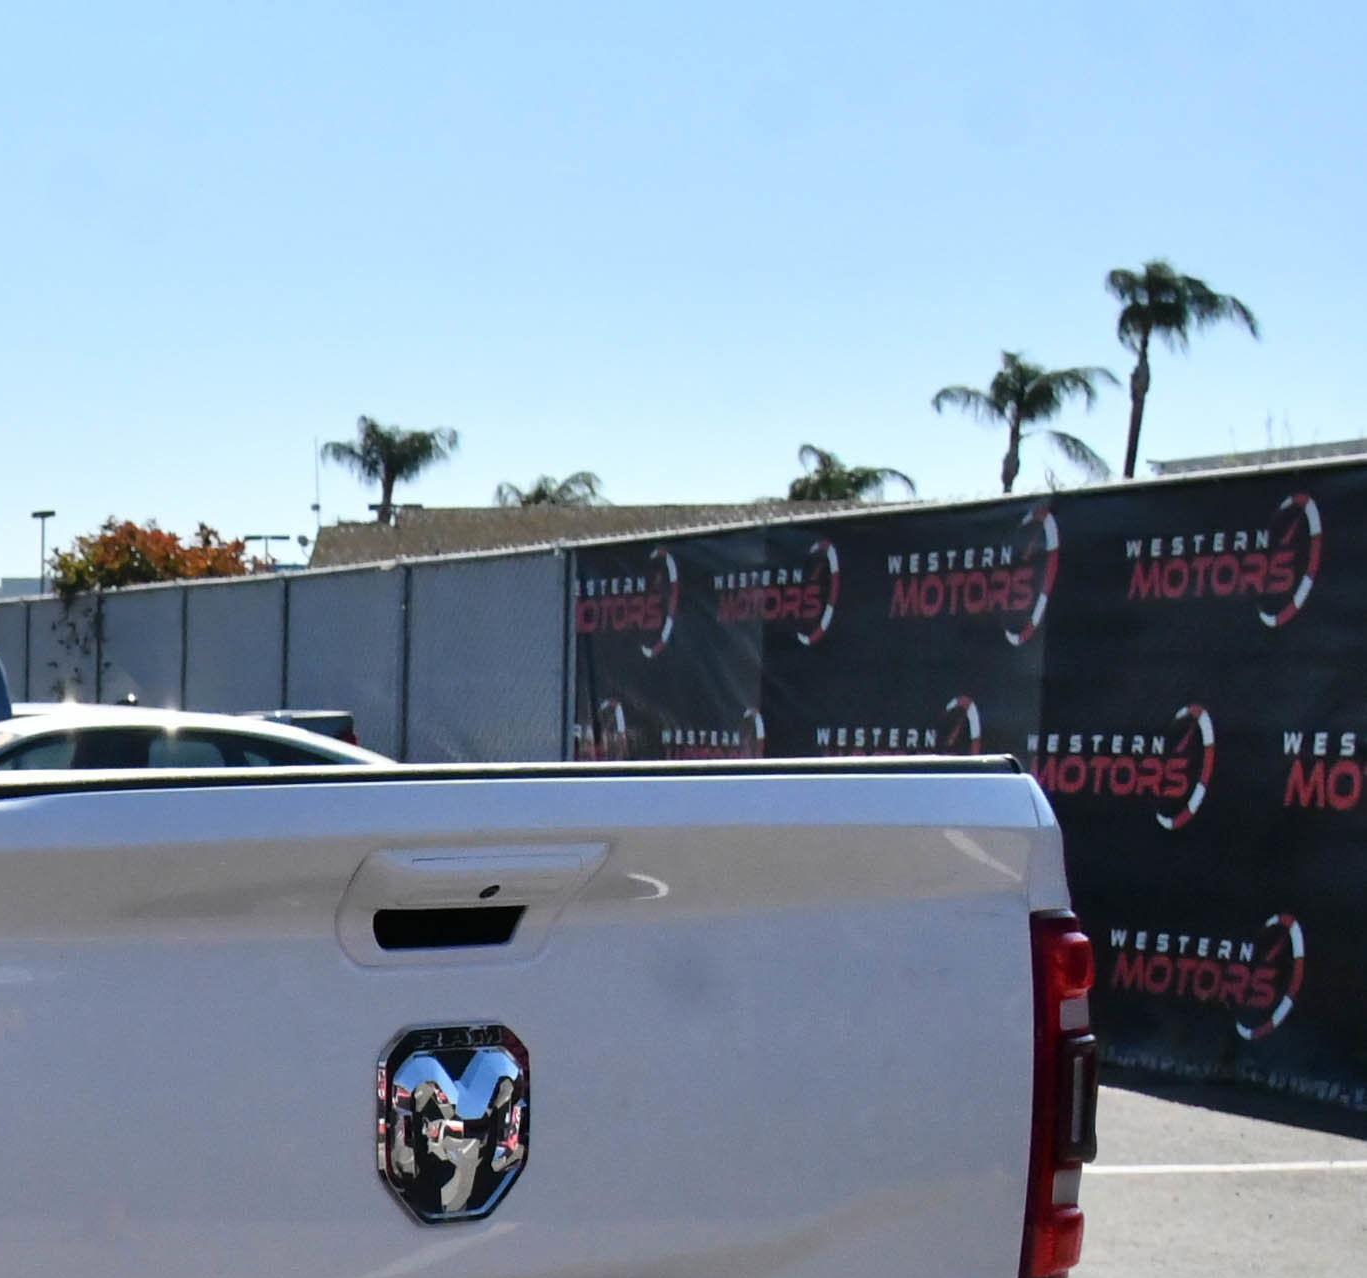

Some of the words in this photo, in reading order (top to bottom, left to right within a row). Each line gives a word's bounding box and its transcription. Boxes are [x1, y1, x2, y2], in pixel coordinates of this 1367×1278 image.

[888, 546, 1012, 574] WESTERN
[1126, 530, 1269, 559] WESTERN
[714, 568, 803, 591] WESTERN
[889, 567, 1034, 619] MOTORS
[1128, 552, 1295, 600] MOTORS
[574, 592, 662, 633] OTORS
[718, 585, 821, 622] MOTORS
[816, 728, 937, 748] WESTERN
[1027, 734, 1165, 754] WESTERN
[1030, 755, 1190, 797] MOTORS
[1284, 759, 1367, 810] MO
[1111, 928, 1254, 962] WESTERN
[1111, 952, 1276, 1009] MOTORS
